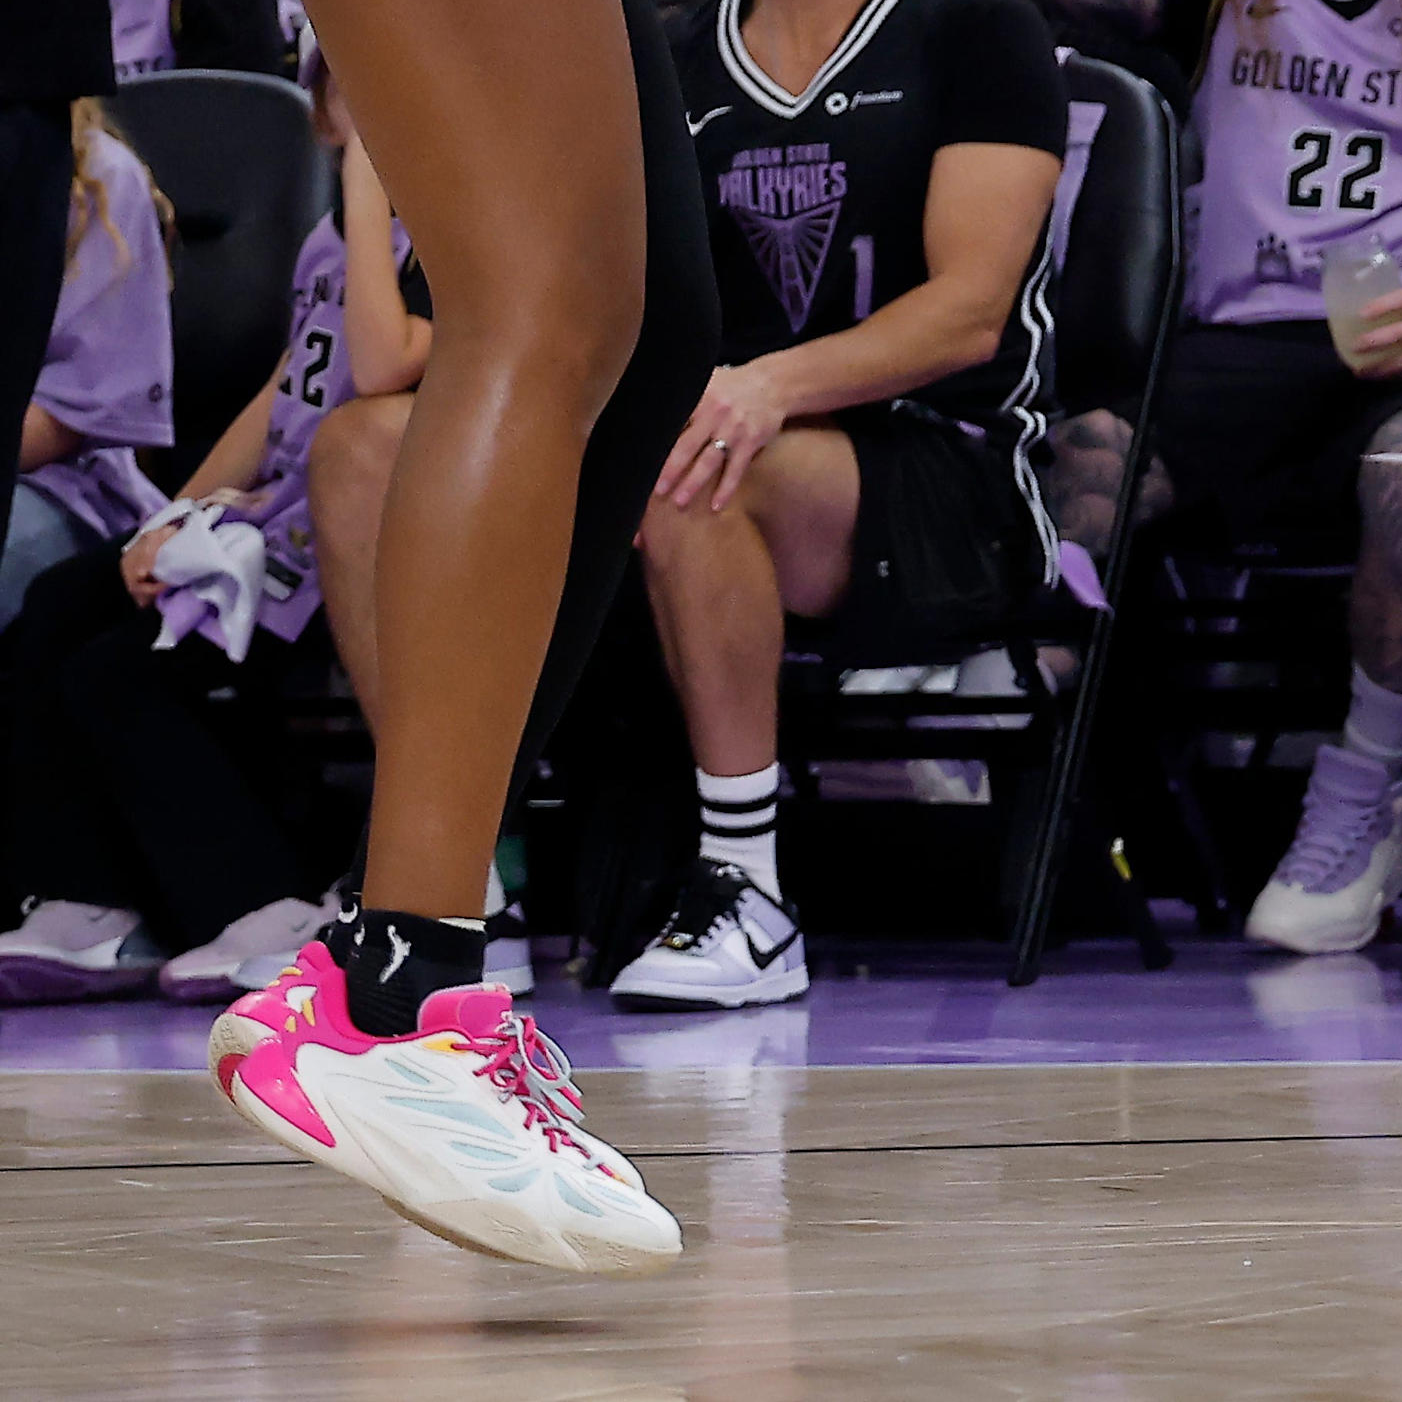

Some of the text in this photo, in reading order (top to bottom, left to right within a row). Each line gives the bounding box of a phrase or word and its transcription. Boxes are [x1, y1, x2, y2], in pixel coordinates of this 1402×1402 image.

[1231, 48, 1350, 98] GOLDEN
[717, 161, 848, 216] VALKYRIES
[1286, 127, 1387, 210] 22
[851, 234, 874, 320] 1
